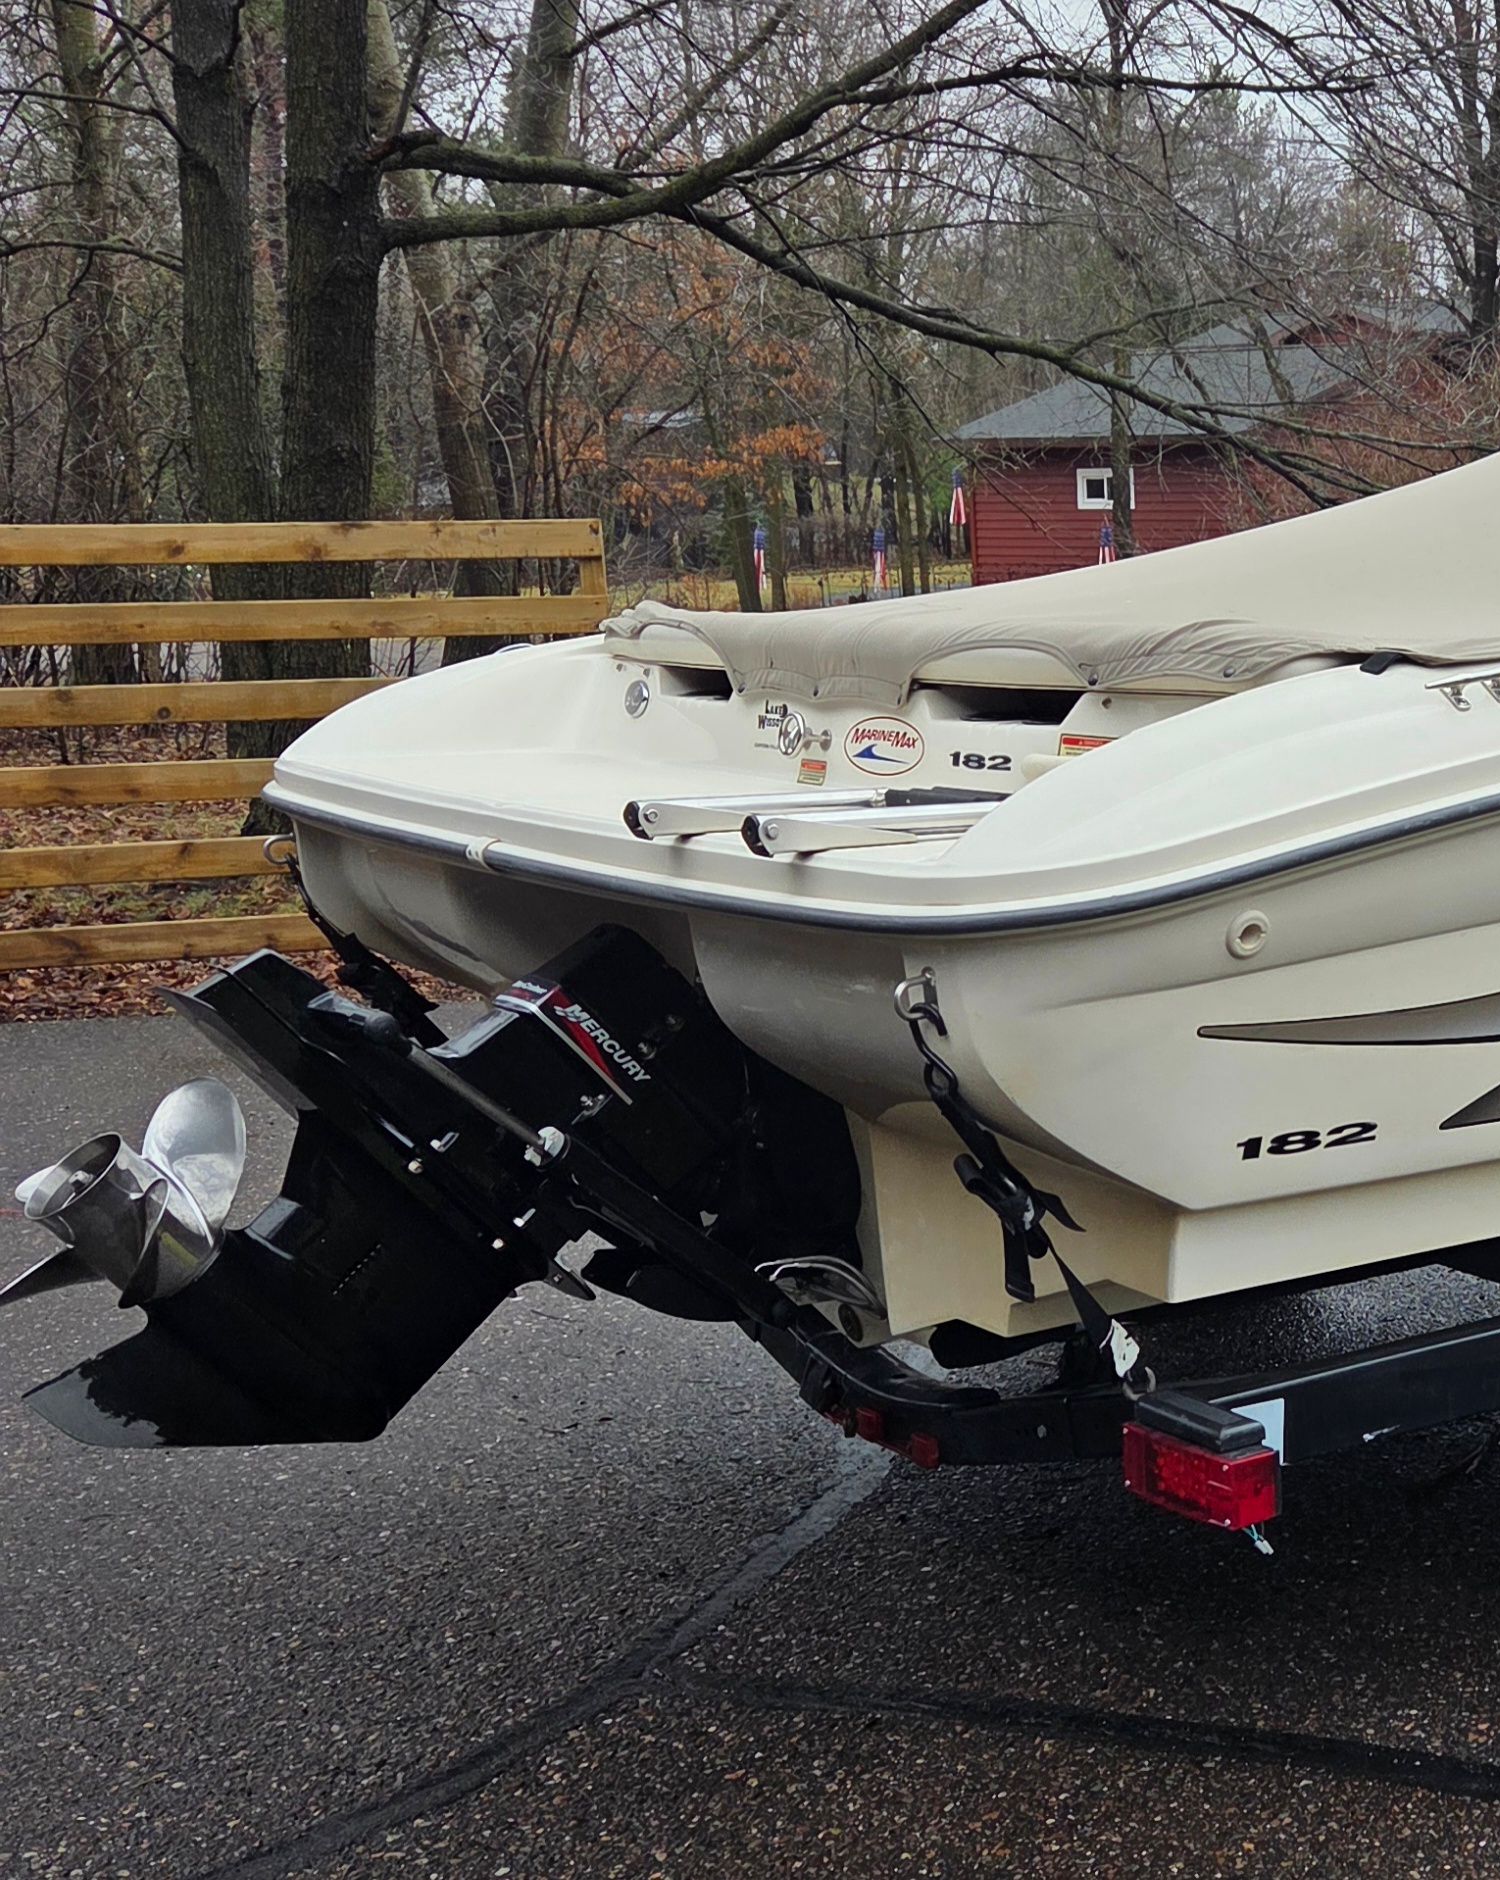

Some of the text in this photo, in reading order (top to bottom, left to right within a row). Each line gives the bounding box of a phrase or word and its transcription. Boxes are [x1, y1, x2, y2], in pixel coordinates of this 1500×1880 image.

[949, 751, 1012, 771] 182
[554, 1003, 652, 1082] MERCURY
[1236, 1121, 1378, 1161] 182
